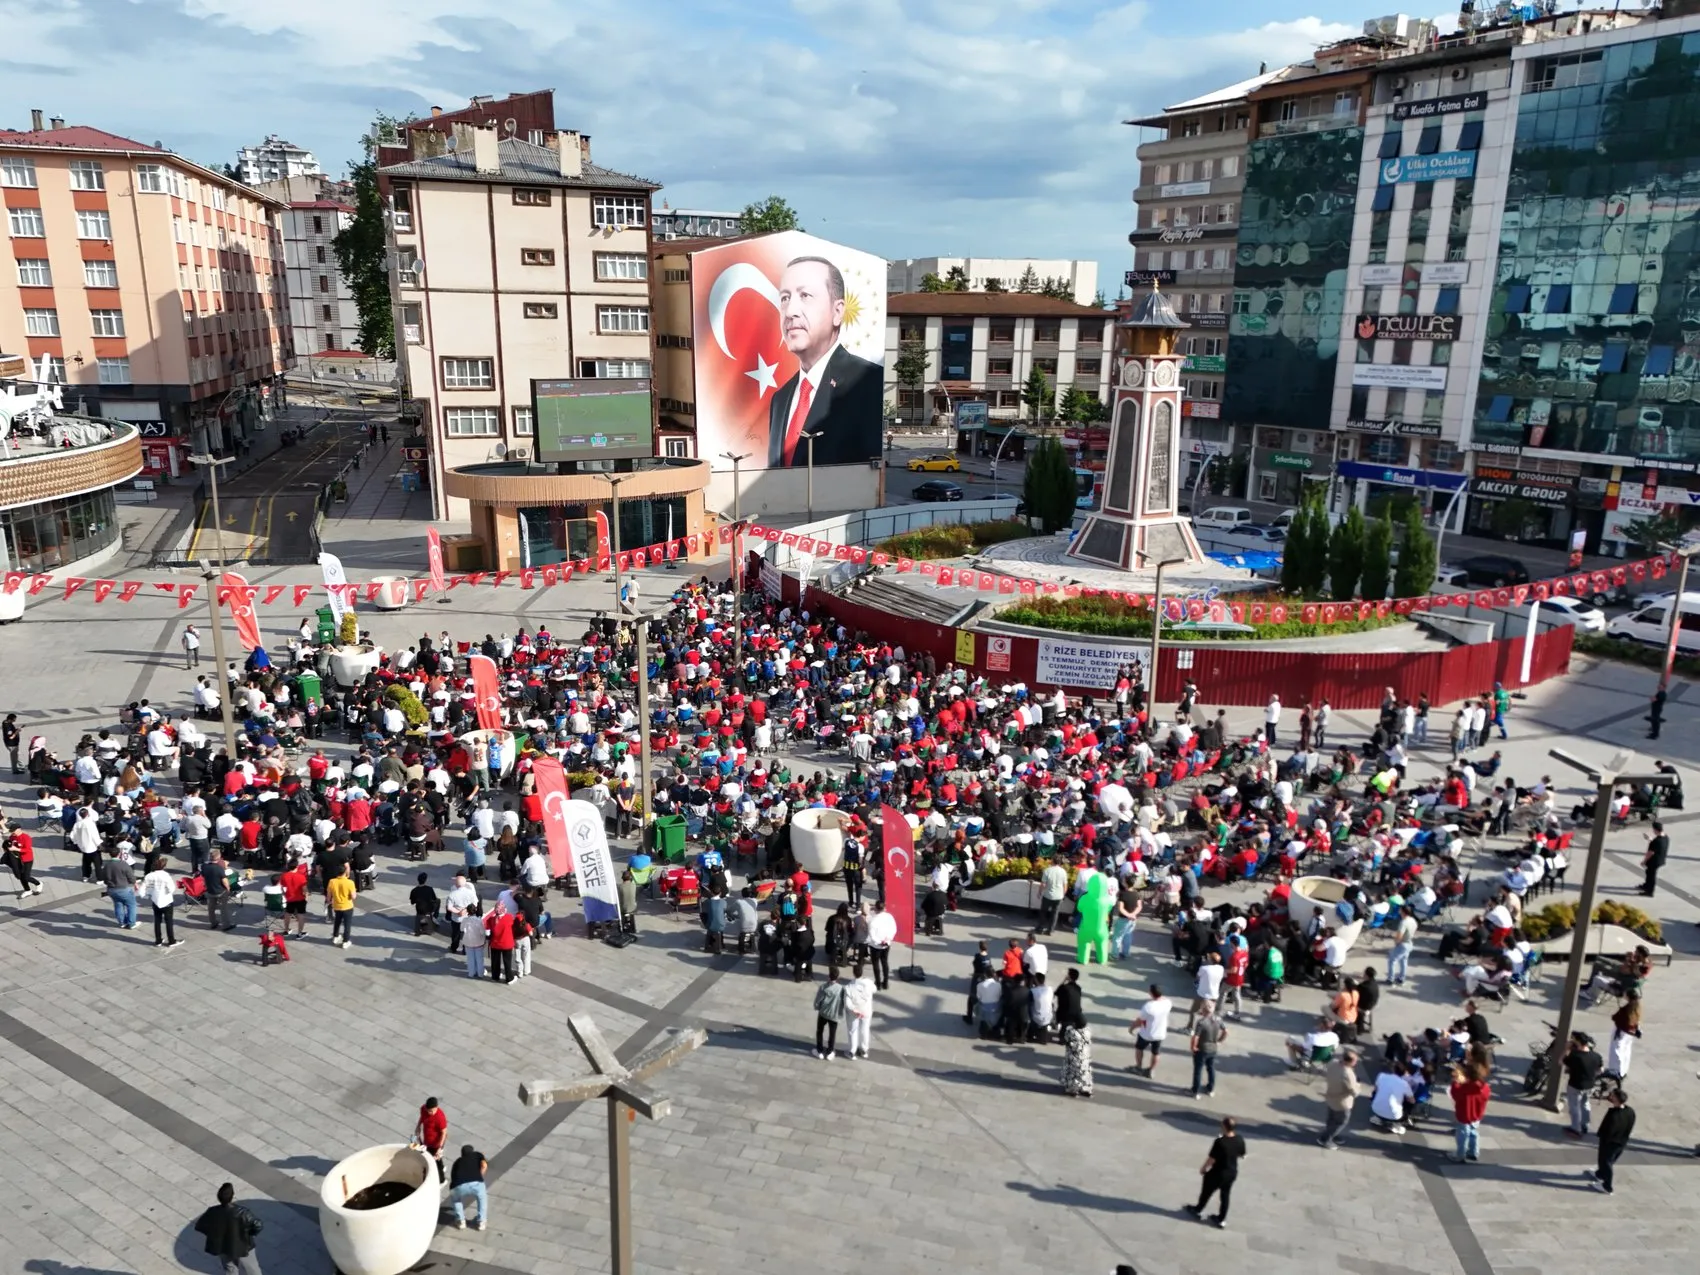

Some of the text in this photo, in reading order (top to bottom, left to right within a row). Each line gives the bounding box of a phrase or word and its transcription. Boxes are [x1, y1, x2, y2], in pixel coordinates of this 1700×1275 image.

[1411, 104, 1435, 115] Kuaför
[1437, 102, 1461, 112] Fatma
[1477, 467, 1513, 479] SHOW
[1522, 487, 1567, 501] GROUP
[1620, 498, 1662, 511] ECZANE
[1054, 645, 1139, 660] RİZE BELEDİYESİ
[1052, 656, 1086, 664] TEMMUZ
[1049, 663, 1101, 673] CUMHURİYET
[1045, 676, 1096, 686] İYİLEŞTİRME
[1055, 670, 1117, 680] ZEMİN İZOLASY
